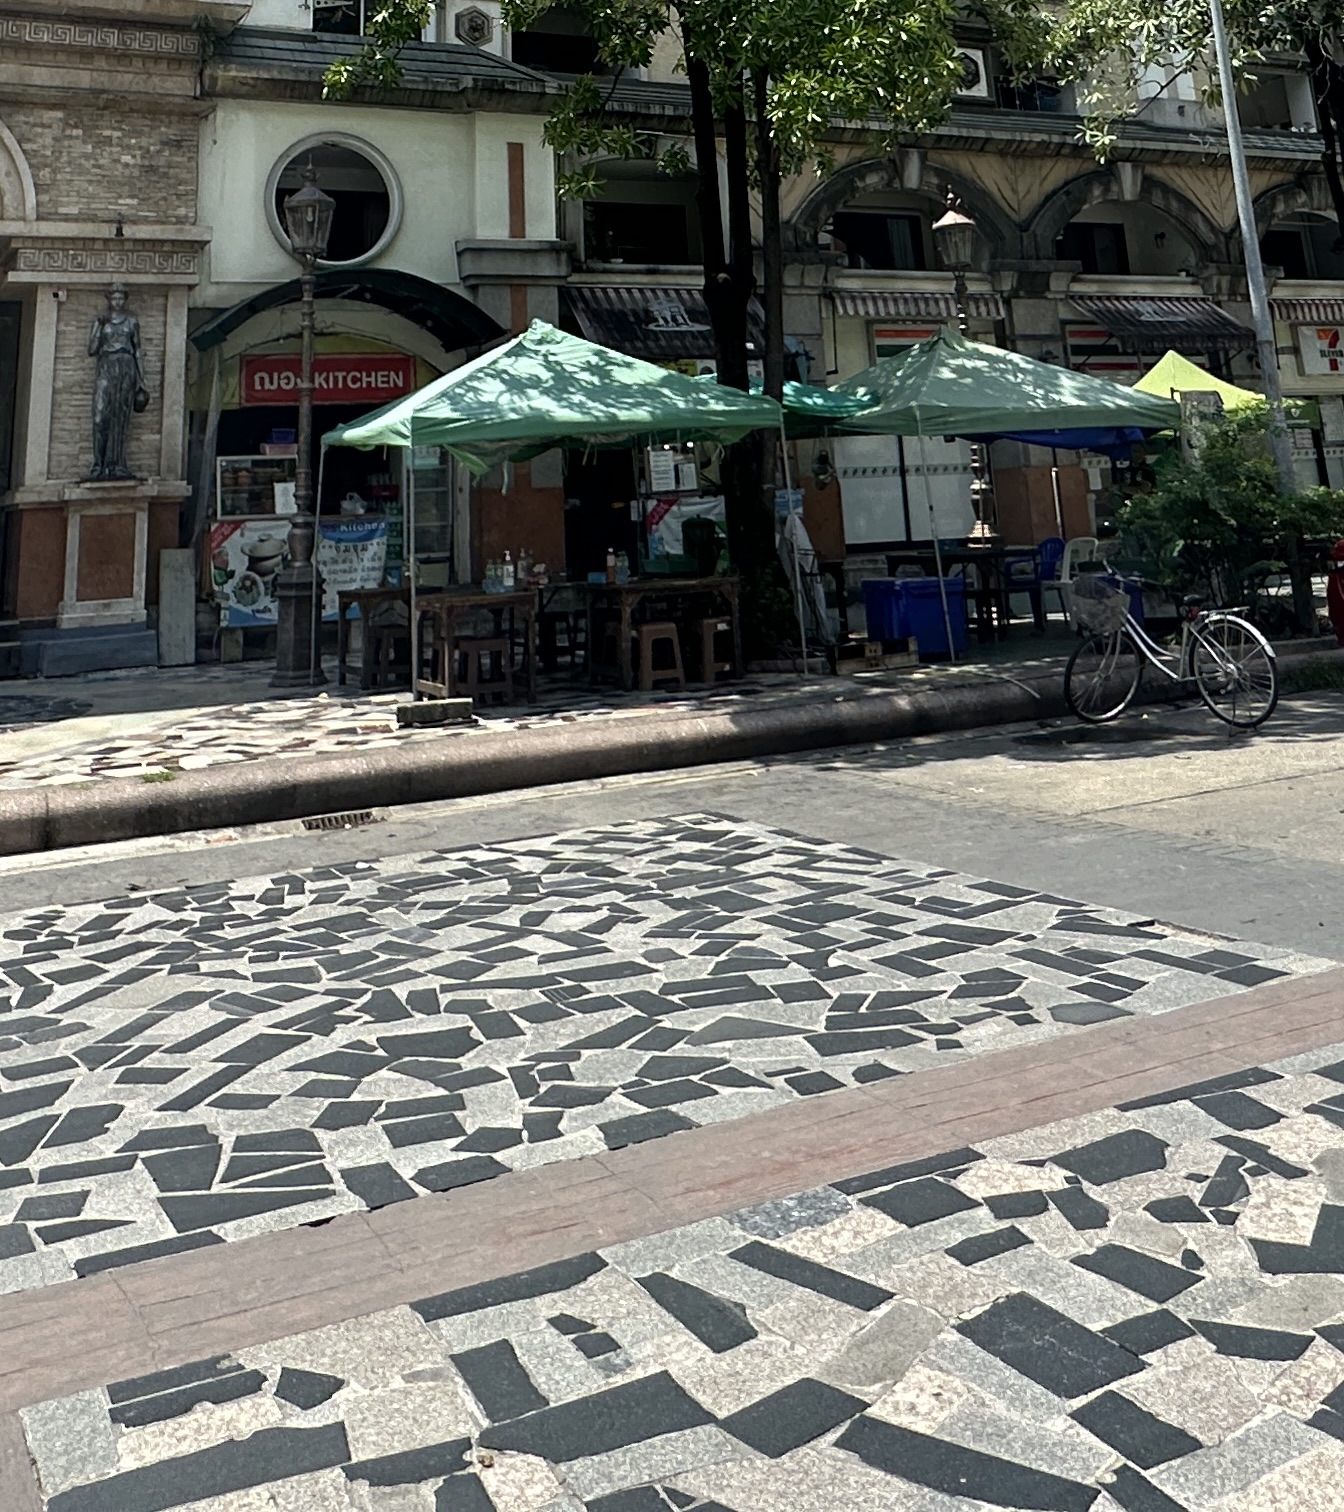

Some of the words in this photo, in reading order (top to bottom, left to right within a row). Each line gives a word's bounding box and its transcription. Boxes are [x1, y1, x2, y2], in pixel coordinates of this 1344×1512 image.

[1316, 328, 1340, 371] 7
[314, 370, 404, 389] KITCHEN
[340, 521, 386, 532] Kitchen
